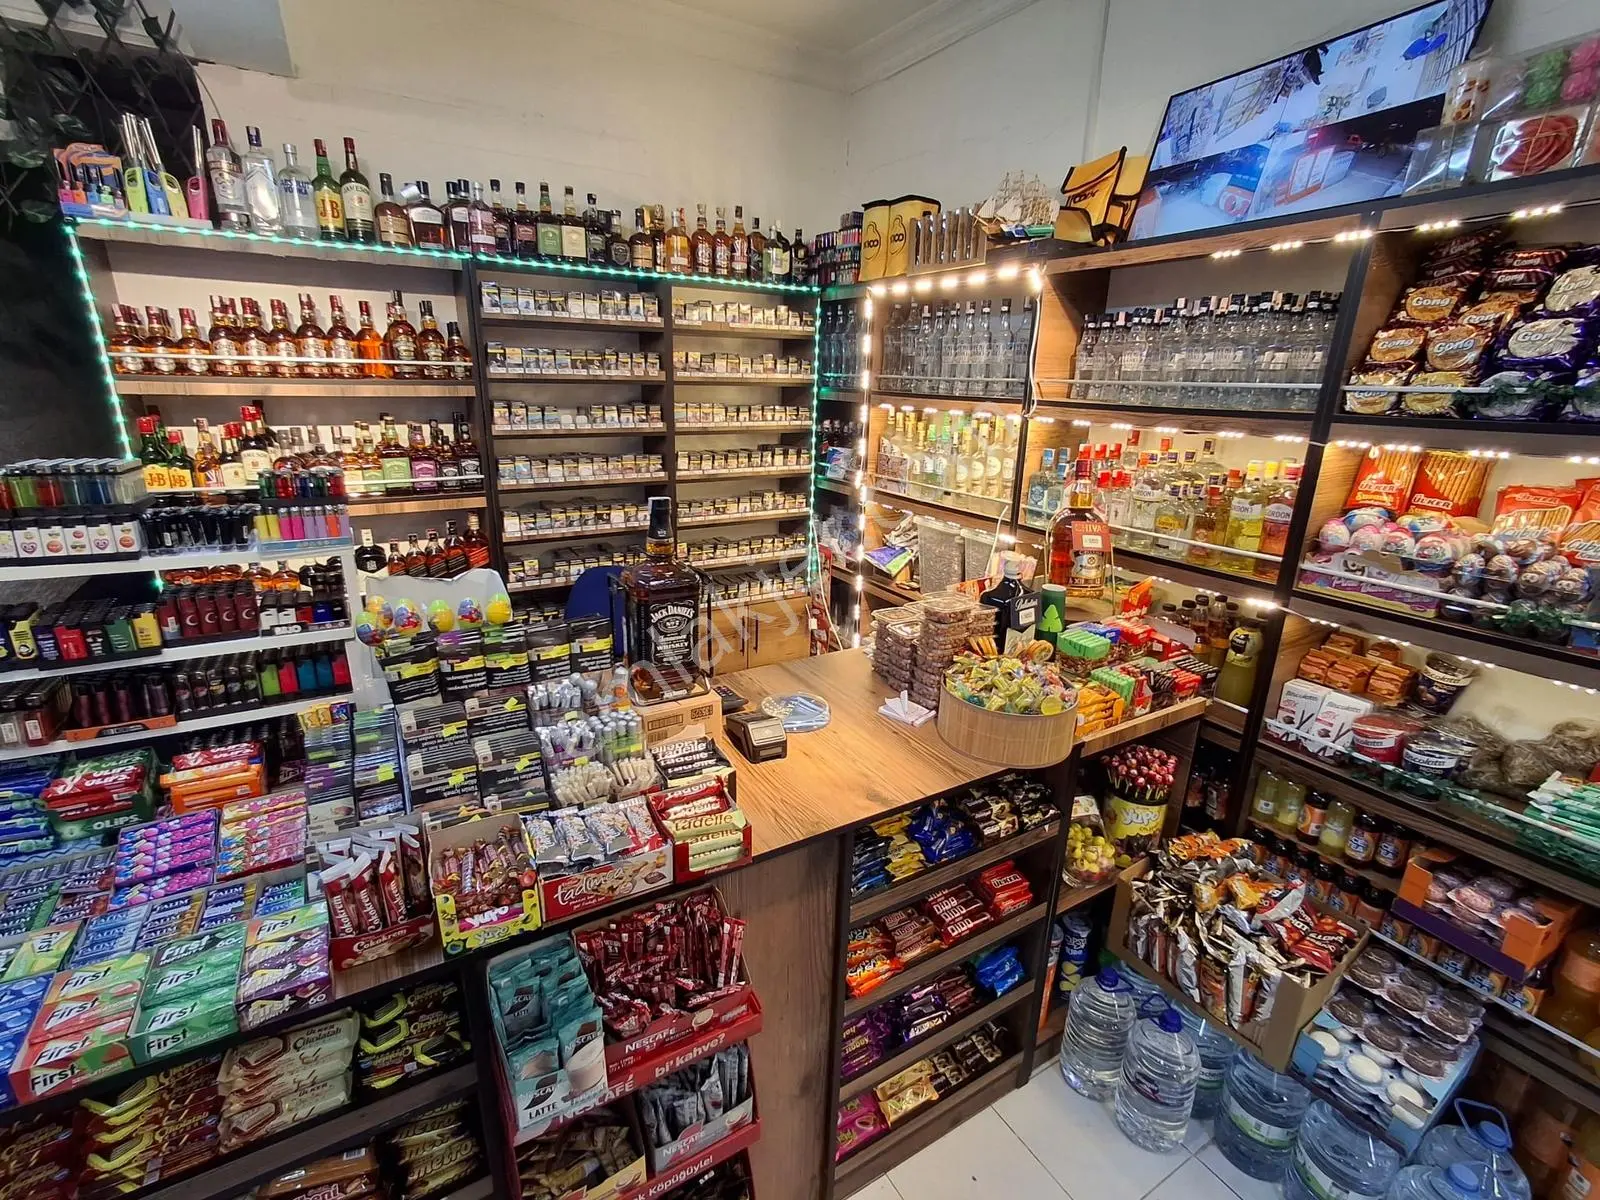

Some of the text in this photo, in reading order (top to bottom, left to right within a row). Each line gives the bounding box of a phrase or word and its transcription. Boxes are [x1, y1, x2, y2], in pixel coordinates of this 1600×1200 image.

[1411, 296, 1451, 308] Gong
[1378, 338, 1415, 351] Gong
[1434, 338, 1477, 356] Gong
[1413, 494, 1454, 509] ÜLKER
[650, 608, 668, 623] JACK
[657, 641, 689, 651] WHISKEY
[84, 774, 132, 788] OLIPS
[92, 813, 143, 831] OLIPS
[675, 814, 733, 832] tadelle
[992, 873, 1022, 888] ÜLKER
[153, 899, 190, 913] FALIM
[935, 897, 958, 915] DIDO
[941, 905, 967, 922] DIDO
[257, 915, 297, 937] First
[948, 918, 974, 937] DIDO
[162, 934, 212, 962] First
[60, 966, 112, 992] First
[156, 965, 203, 990] First
[302, 965, 321, 977] 60
[308, 992, 327, 1006] 60
[45, 997, 100, 1026] First
[147, 1001, 198, 1029] First
[146, 1027, 188, 1054] First
[675, 1032, 727, 1067] kahve?
[33, 1035, 90, 1066] First
[31, 1063, 77, 1092] First
[528, 1101, 559, 1121] LATTE
[414, 1138, 473, 1181] metro
[648, 1155, 714, 1198] Köpüğüyle!
